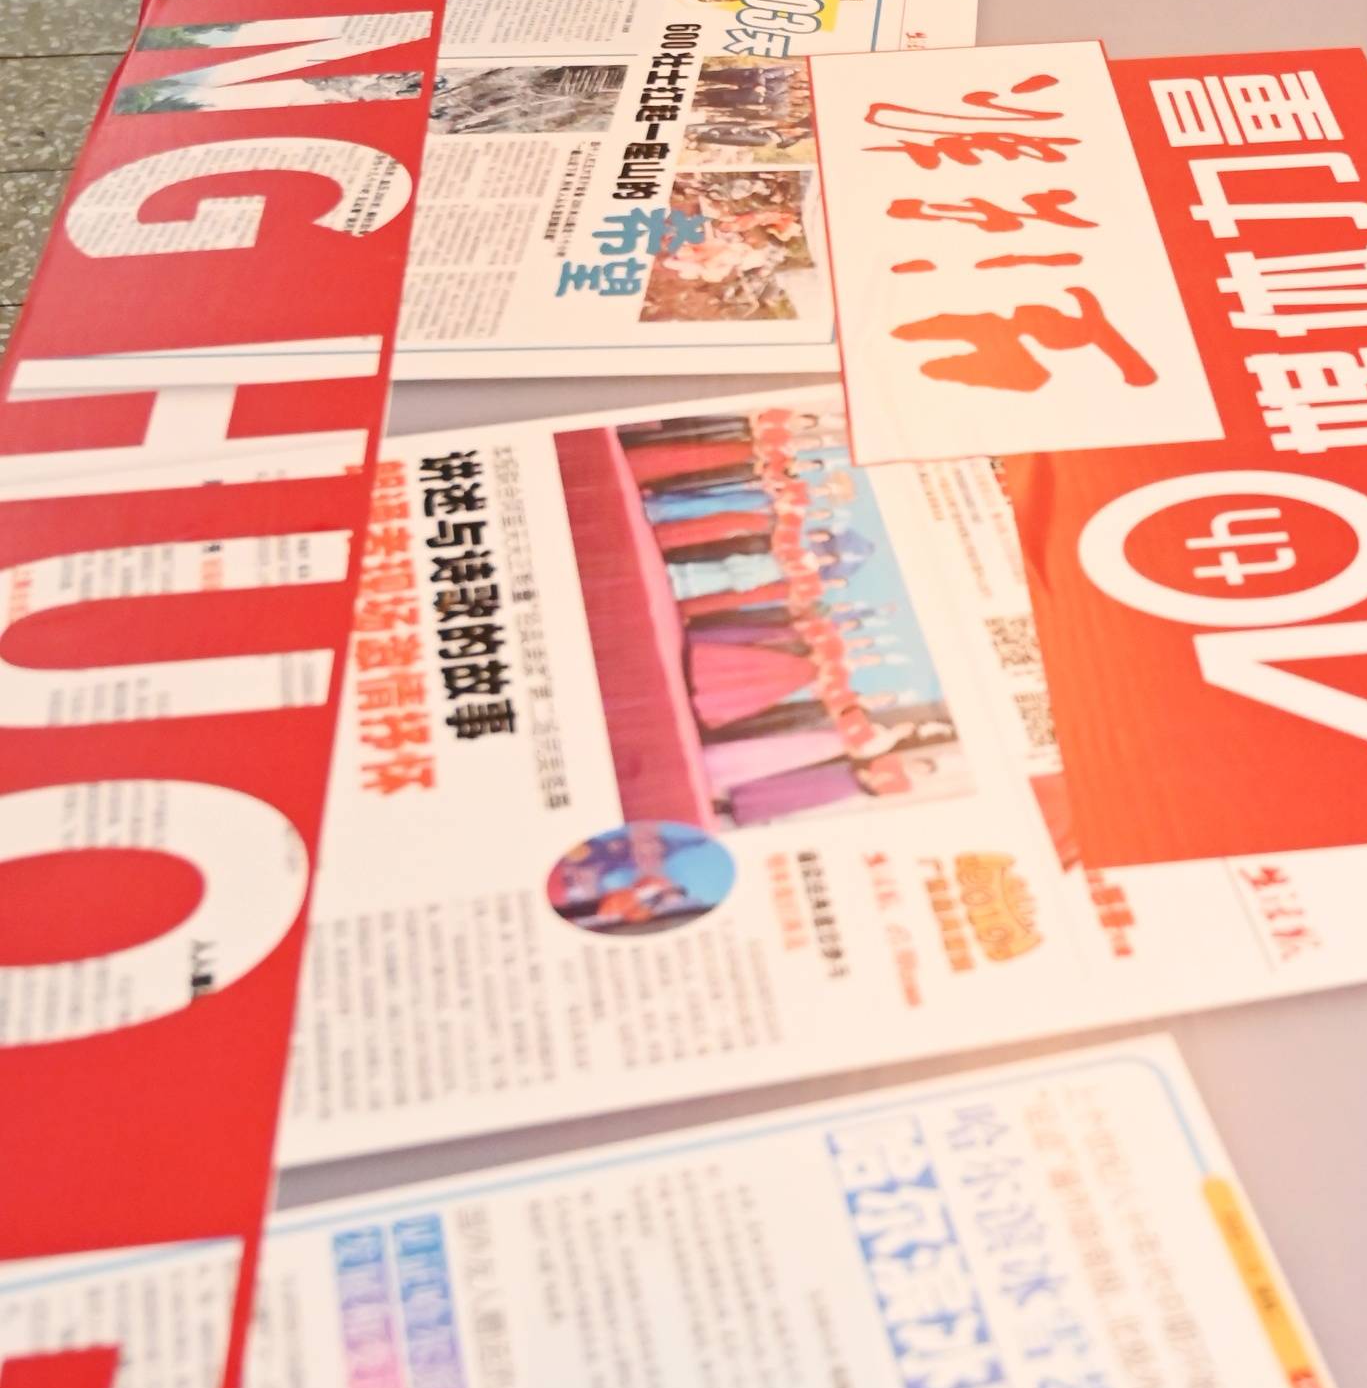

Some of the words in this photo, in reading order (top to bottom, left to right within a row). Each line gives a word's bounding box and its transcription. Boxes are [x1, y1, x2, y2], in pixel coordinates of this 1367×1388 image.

[612, 22, 702, 201] 600壮士扛起一座山的
[554, 206, 709, 298] 希望
[417, 448, 519, 742] 讲述与诗歌的故事
